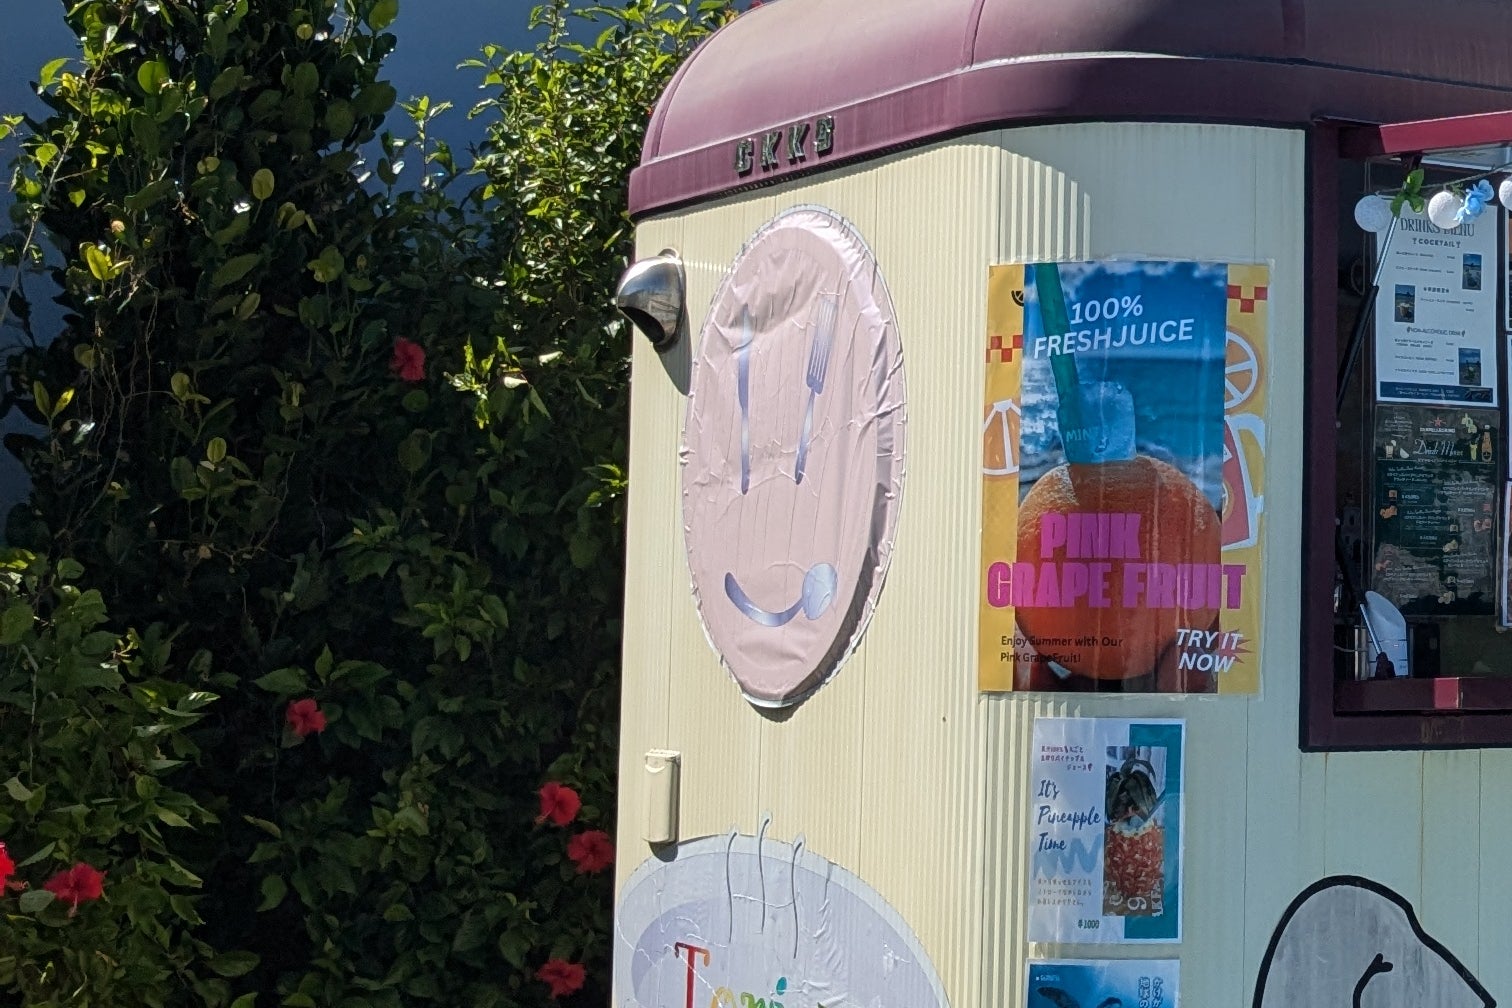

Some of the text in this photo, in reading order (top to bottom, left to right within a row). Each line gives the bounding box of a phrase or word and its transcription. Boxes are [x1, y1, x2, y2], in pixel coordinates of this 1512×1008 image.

[1418, 238, 1456, 248] COCKTAIL
[1070, 295, 1144, 325] 100%
[1033, 318, 1195, 359] FRESHJUICE
[1040, 512, 1141, 559] PINK
[987, 561, 1247, 610] GRAPE FRUIT
[1001, 635, 1123, 648] Enjoy Summer with Our
[1176, 628, 1244, 650] TRY IT
[1000, 652, 1021, 663] Pink
[1178, 652, 1236, 673] NOW
[1038, 805, 1101, 831] Pineapple
[1038, 832, 1067, 852] Time
